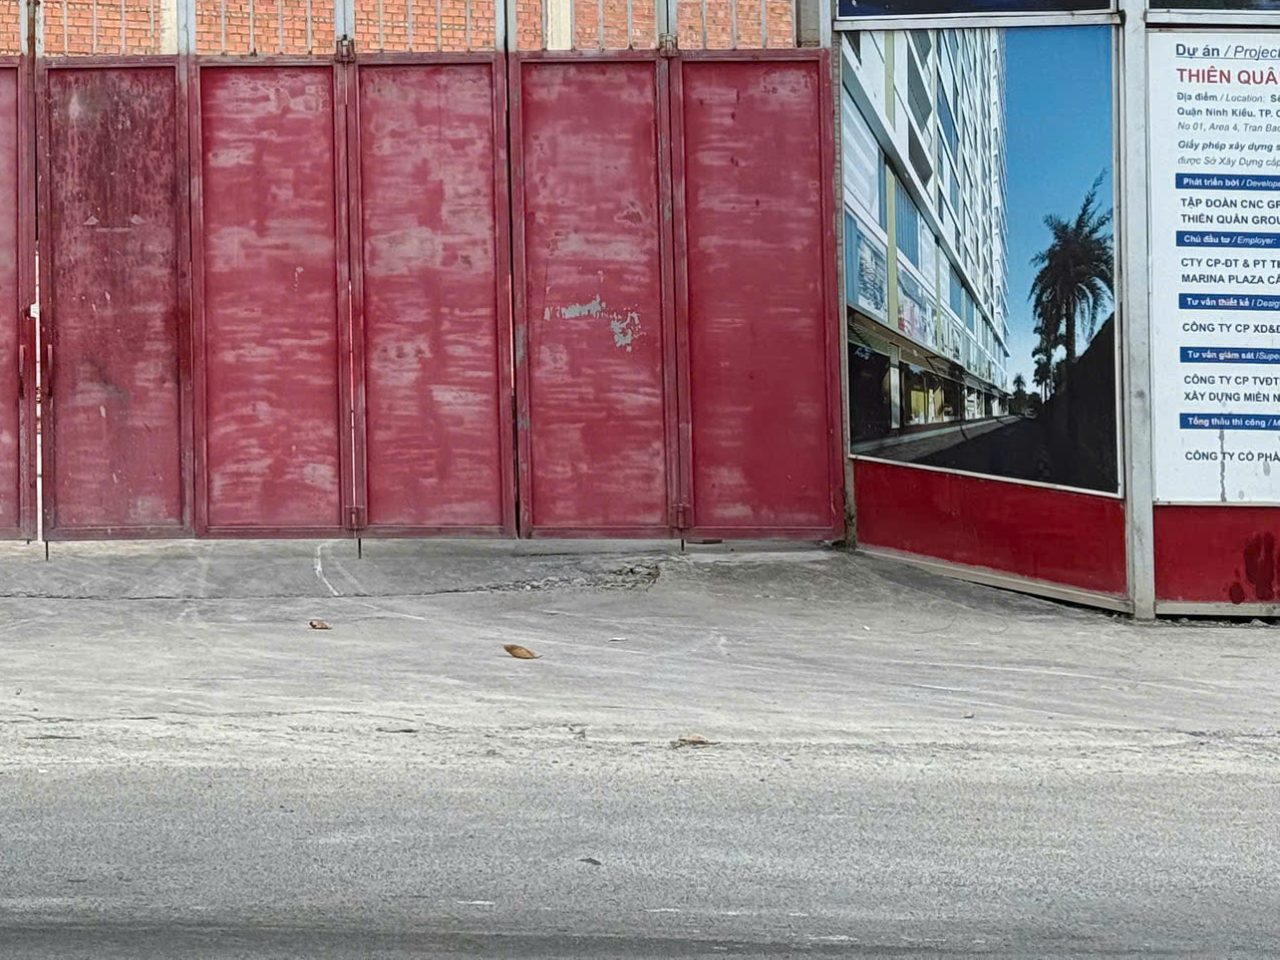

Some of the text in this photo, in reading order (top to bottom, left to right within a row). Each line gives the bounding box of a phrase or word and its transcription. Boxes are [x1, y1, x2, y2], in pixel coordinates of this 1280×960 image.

[1176, 44, 1198, 58] Dự
[1202, 45, 1220, 56] án
[1176, 65, 1278, 85] THIÊN QUÂ
[1206, 108, 1228, 117] Ninh
[1244, 123, 1263, 132] Tran
[1181, 196, 1202, 209] TẬP
[1206, 196, 1237, 208] ĐOÀN
[1240, 200, 1264, 208] CNC
[1181, 214, 1214, 224] THIÊN
[1216, 213, 1248, 224] QUÂN
[1181, 258, 1202, 267] CTY
[1242, 259, 1250, 268] &
[1254, 260, 1268, 268] PT
[1182, 274, 1224, 284] MARINA
[1228, 275, 1264, 284] PLAZA
[1182, 321, 1215, 332] CÔNG
[1218, 324, 1232, 332] TY
[1235, 324, 1250, 332] CP
[1184, 374, 1216, 384] CÔNG
[1218, 376, 1232, 384] TY
[1234, 376, 1249, 384] CP
[1184, 390, 1206, 401] XÂY
[1208, 392, 1240, 402] DỰNG
[1185, 450, 1218, 460] CÔNG
[1221, 452, 1235, 461] TY
